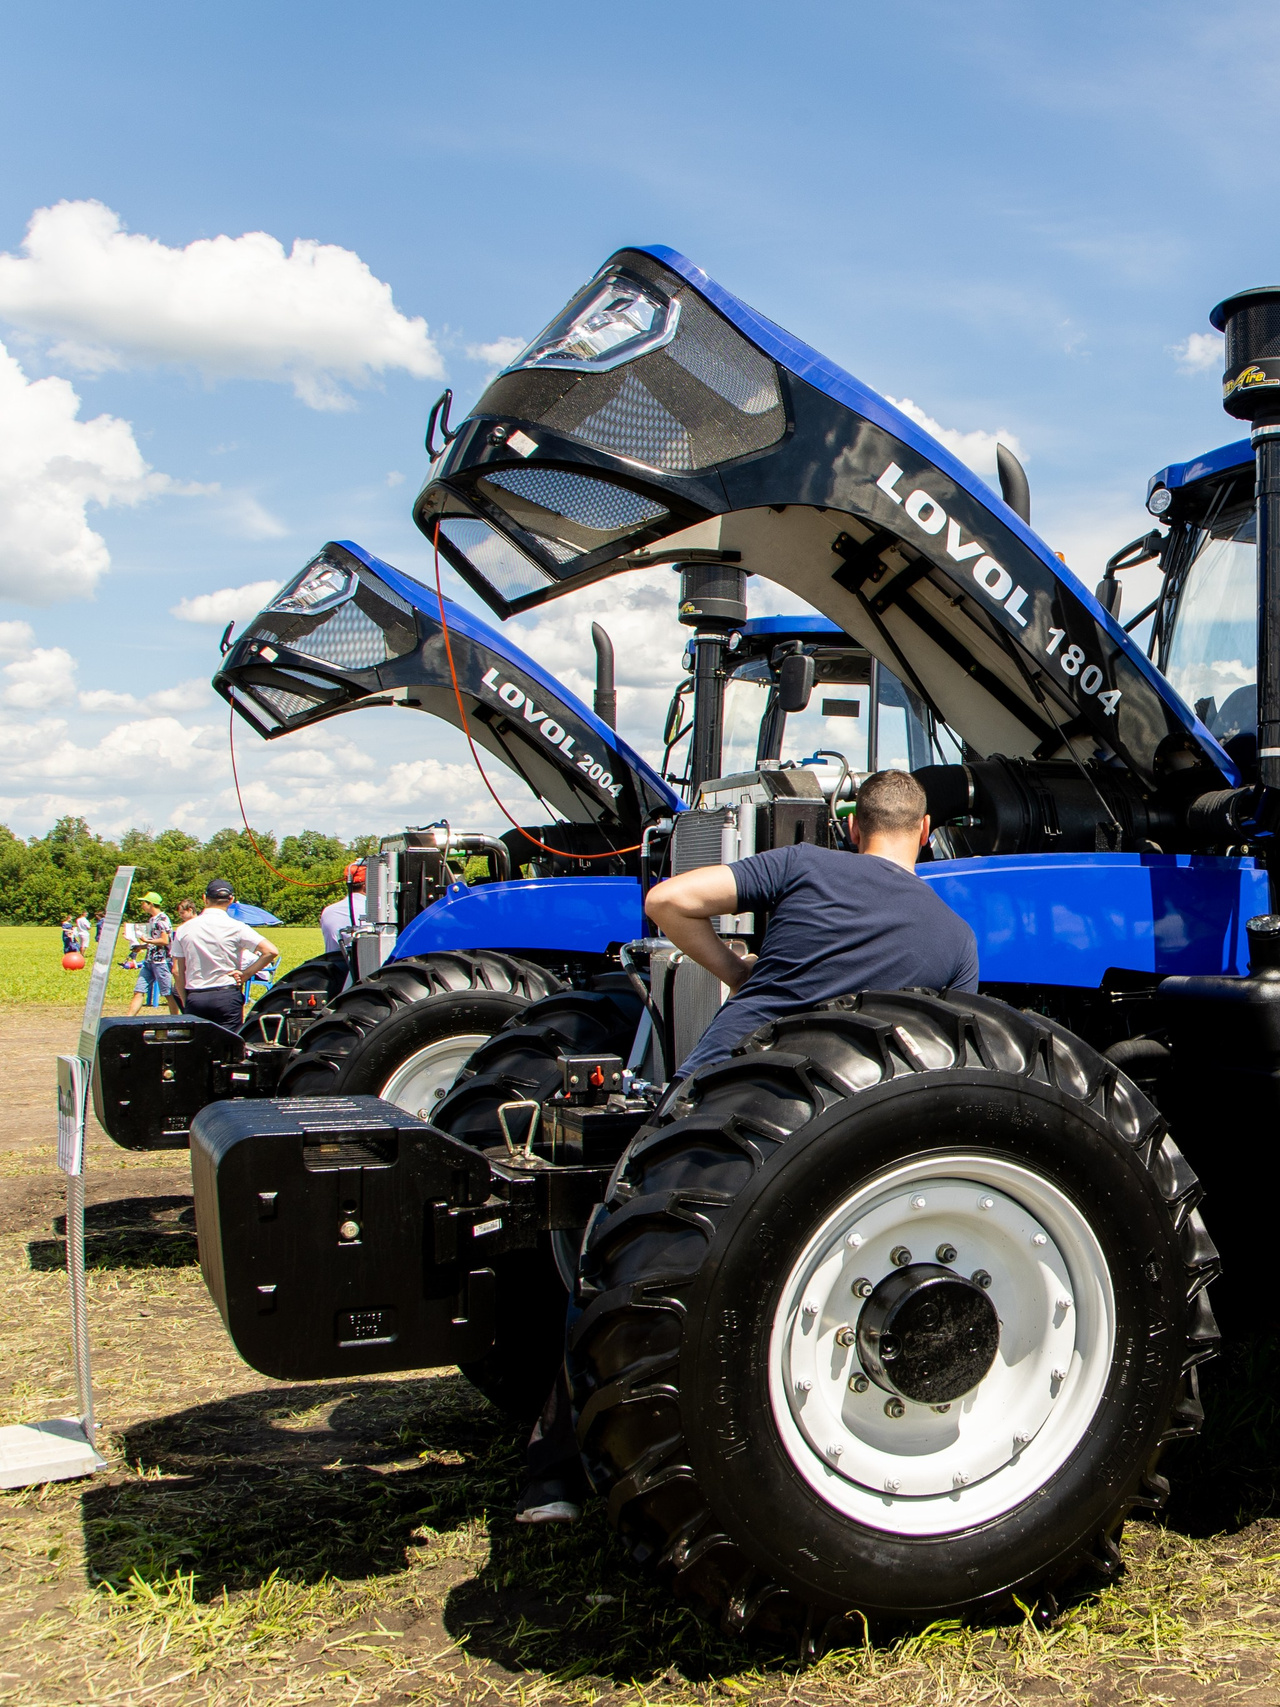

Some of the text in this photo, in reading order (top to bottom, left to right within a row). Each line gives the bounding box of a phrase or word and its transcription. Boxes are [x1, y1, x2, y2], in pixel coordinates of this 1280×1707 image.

[876, 461, 1123, 716] LOVOL 1804
[481, 667, 623, 799] LOVOL 2004
[713, 1309, 746, 1461] 16.9-28
